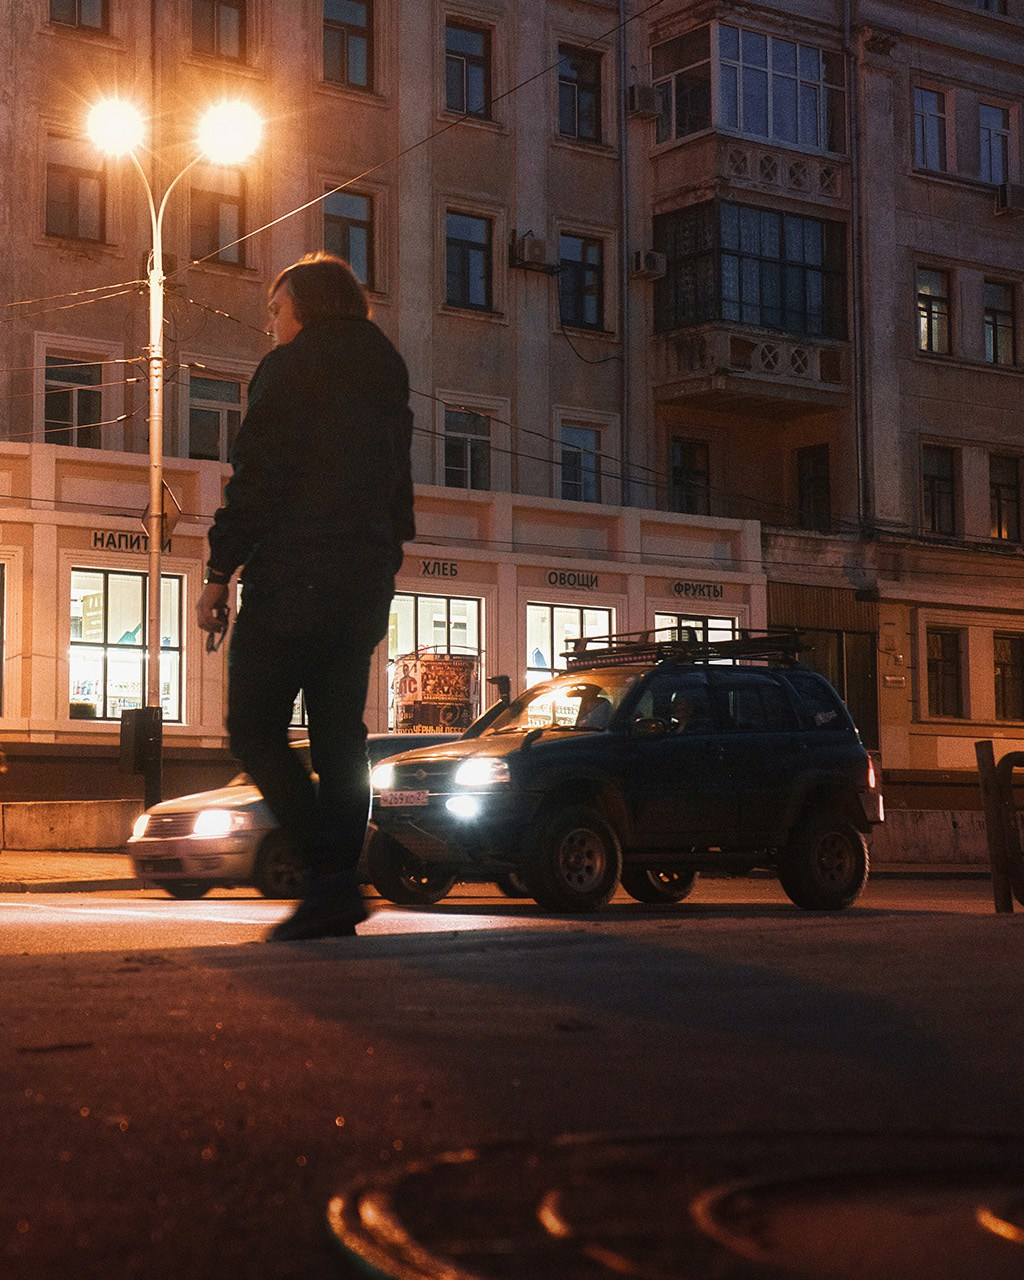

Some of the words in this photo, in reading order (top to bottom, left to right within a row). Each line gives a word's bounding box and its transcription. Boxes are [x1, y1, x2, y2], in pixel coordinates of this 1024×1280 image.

[93, 531, 172, 554] НАПИТИ
[422, 560, 458, 577] ХЛЕБ
[548, 571, 599, 589] ОВОЩИ
[673, 581, 724, 598] ФРУКТЫ
